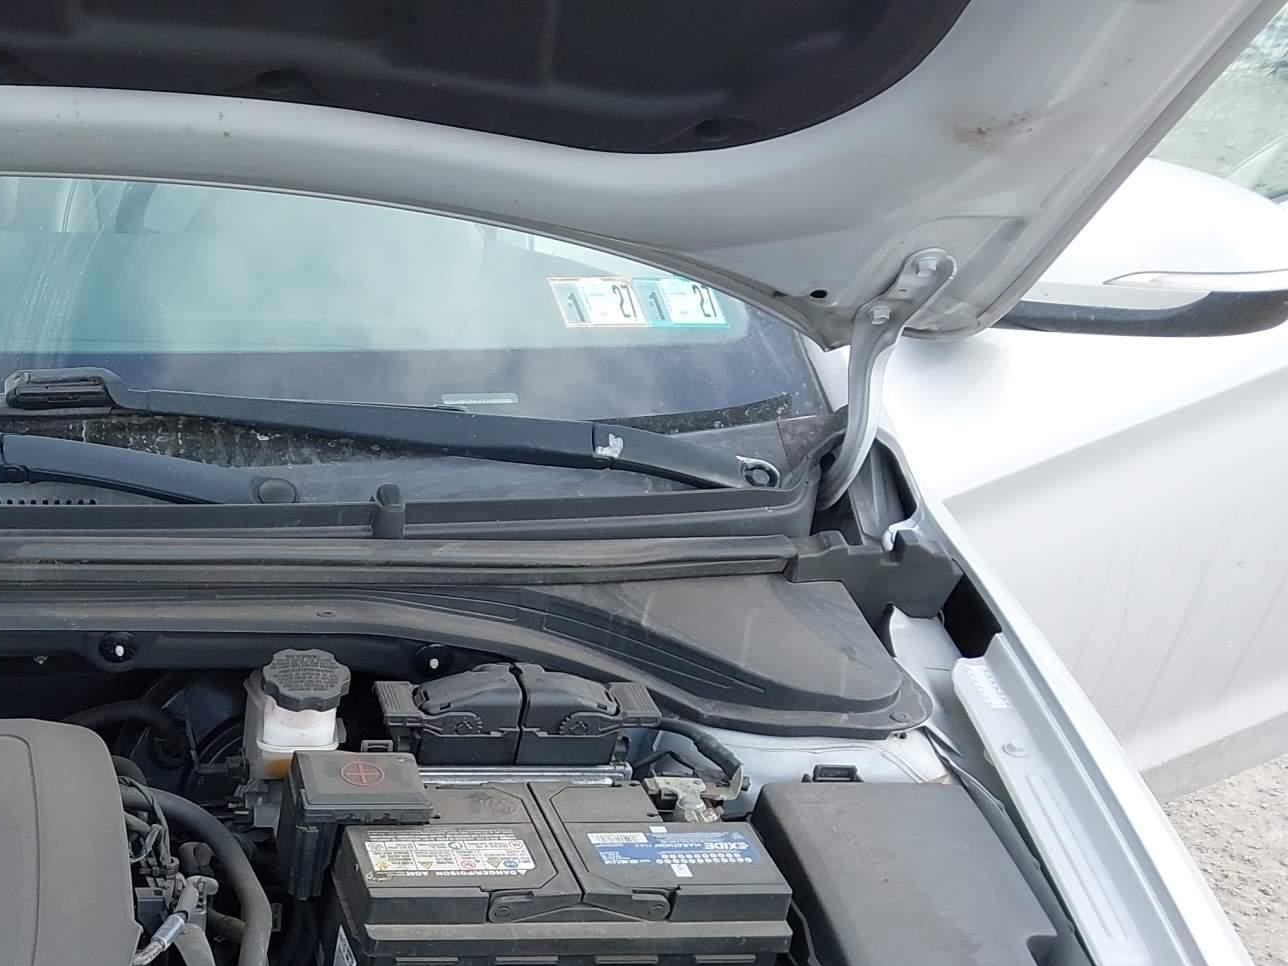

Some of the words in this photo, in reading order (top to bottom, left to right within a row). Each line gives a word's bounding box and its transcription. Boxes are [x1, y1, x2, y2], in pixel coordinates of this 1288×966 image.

[612, 284, 638, 321] 27
[691, 284, 718, 318] 27
[704, 842, 749, 850] EXIDE
